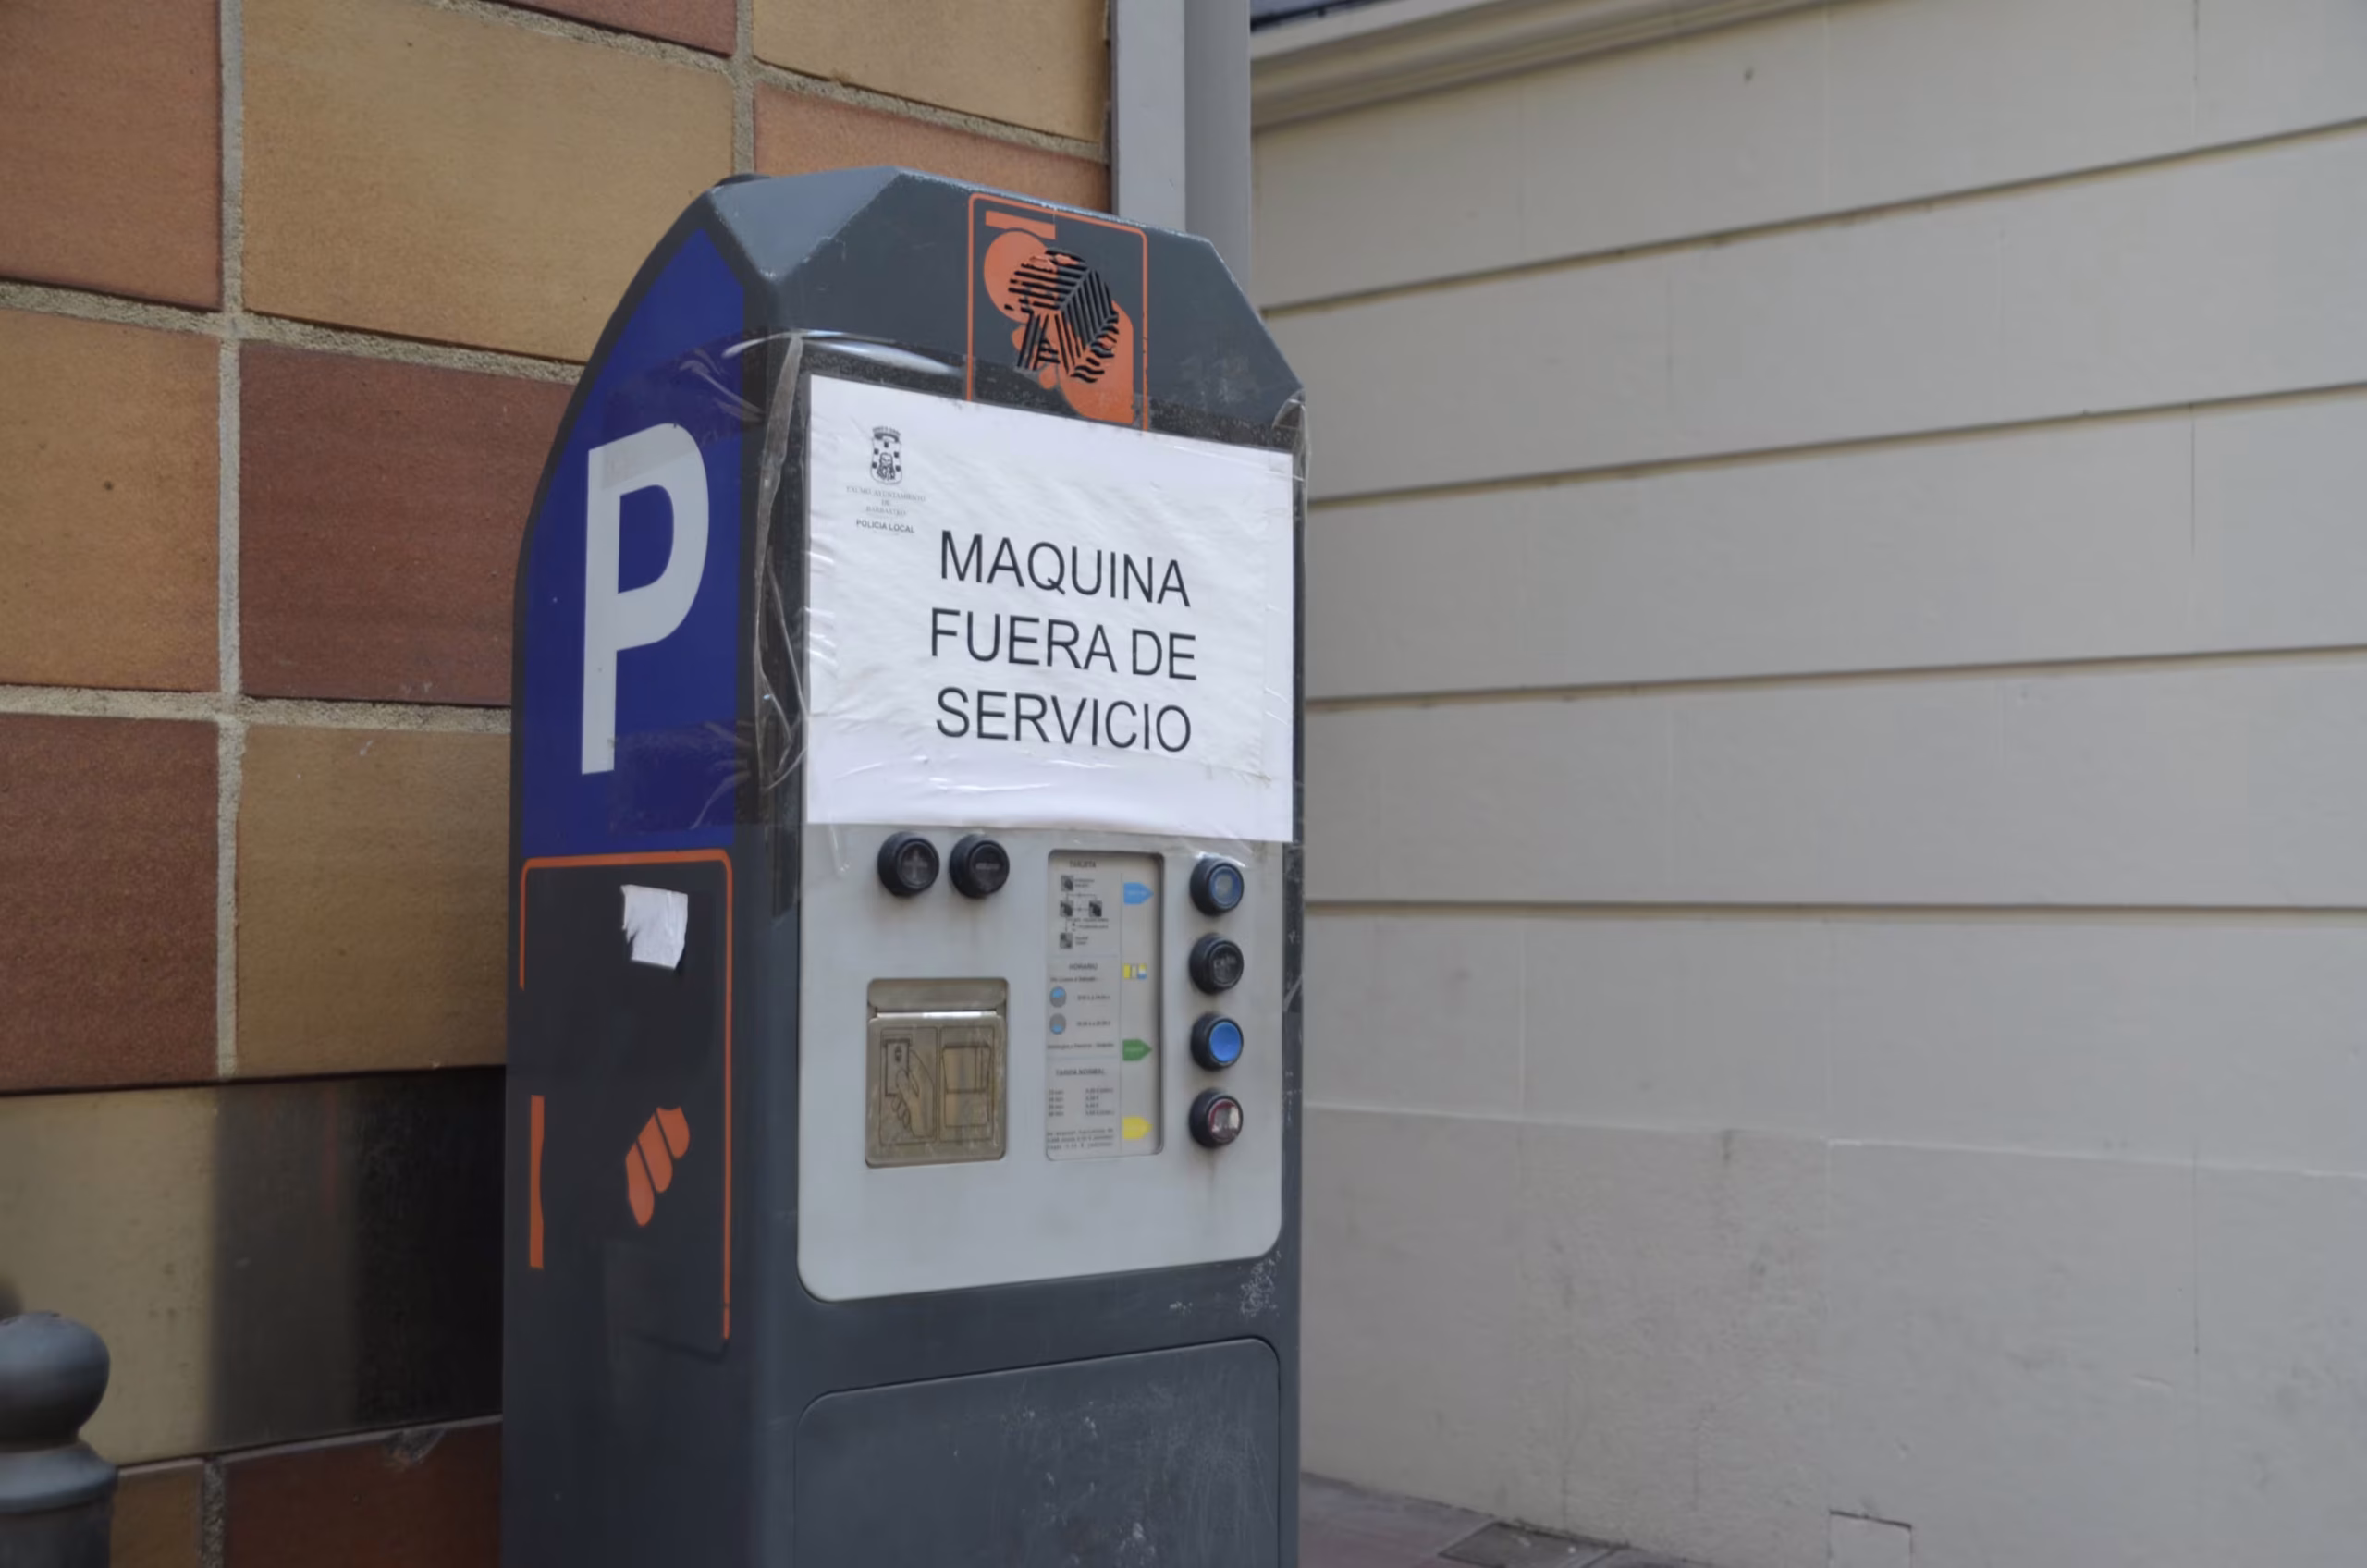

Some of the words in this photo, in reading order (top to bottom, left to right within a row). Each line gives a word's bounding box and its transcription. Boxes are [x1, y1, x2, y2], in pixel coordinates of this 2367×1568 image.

[856, 518, 888, 530] POLICIA
[889, 523, 915, 533] LOCAL
[582, 423, 710, 775] P
[940, 530, 1191, 607] MAQUINA
[931, 607, 1118, 673] FUERA
[1132, 628, 1197, 681] DE
[936, 686, 1192, 753] SERVICIO
